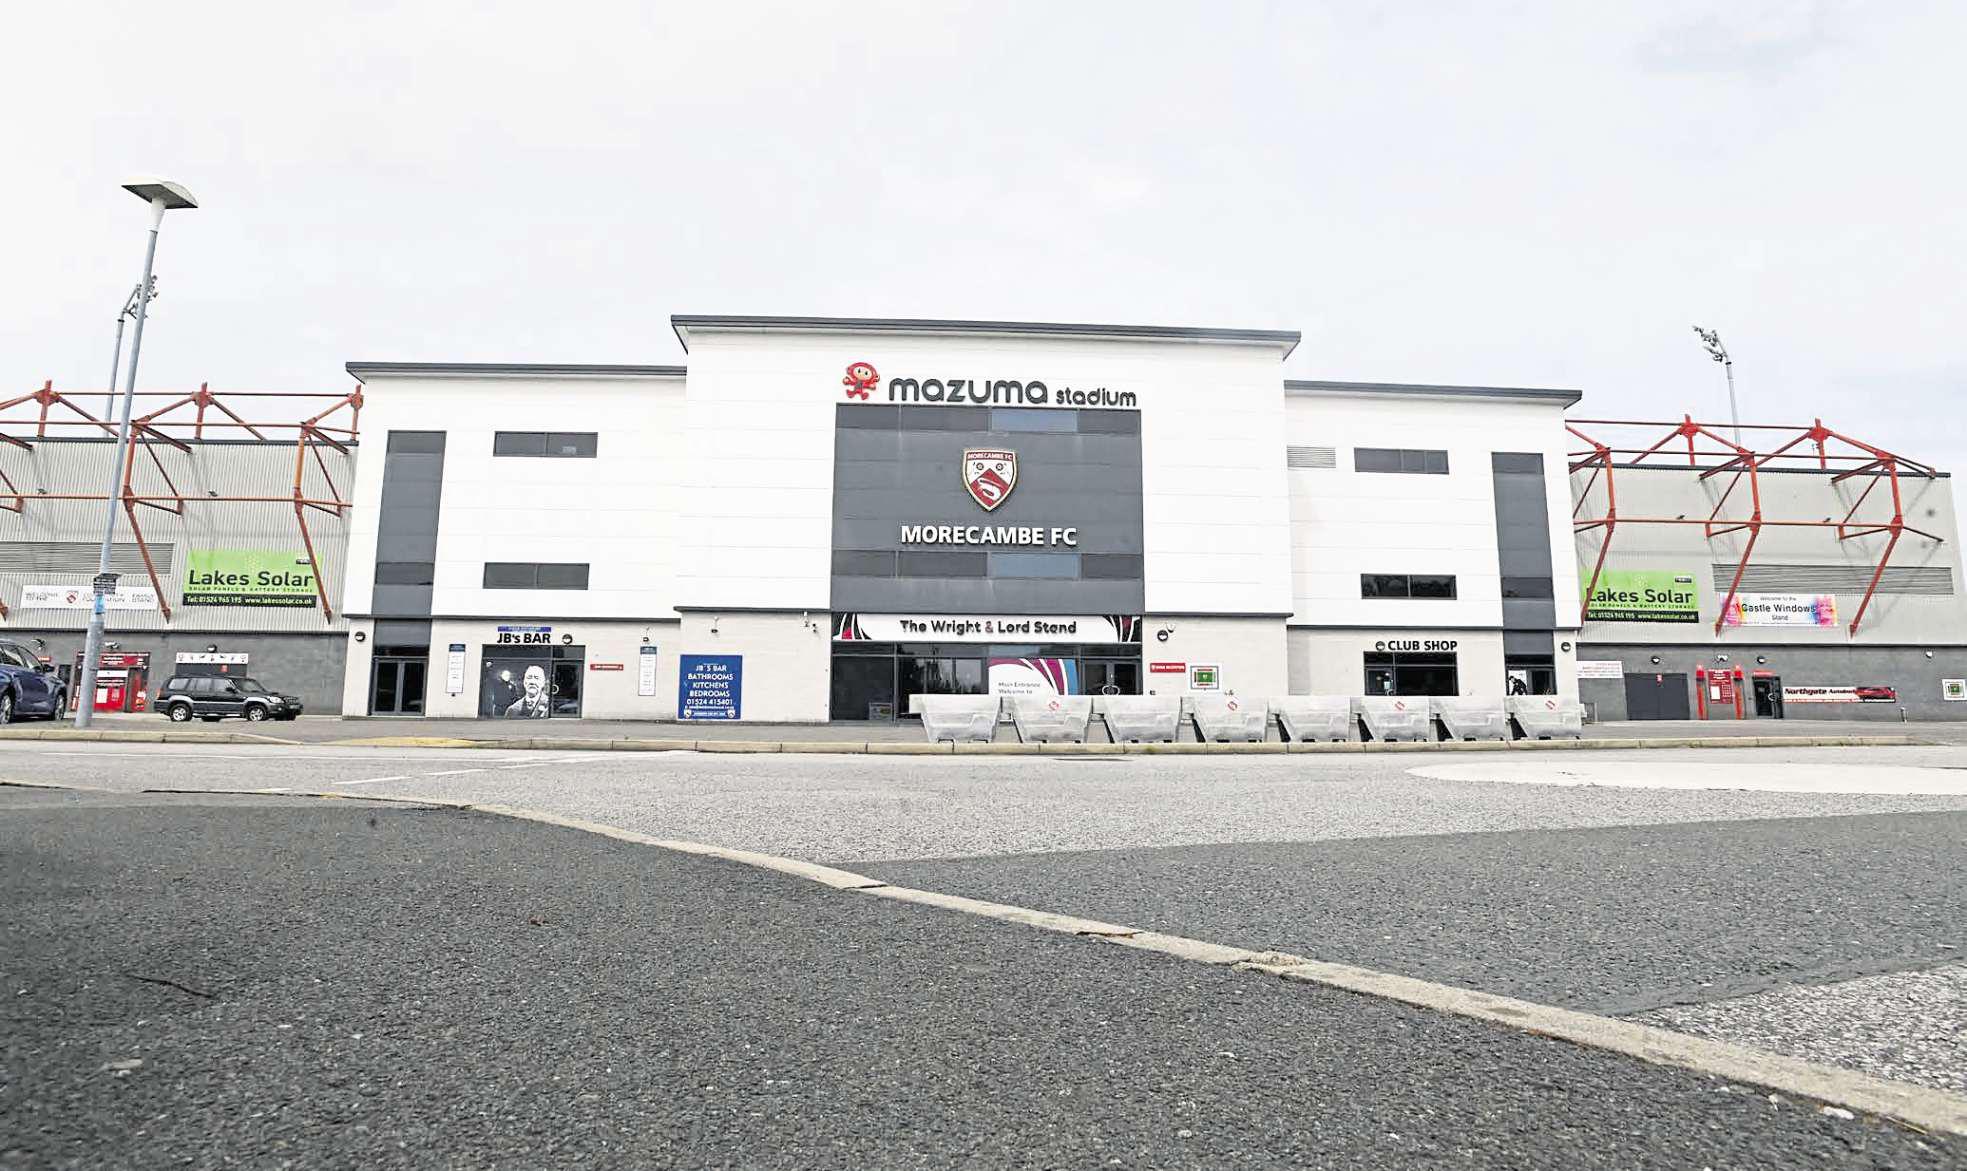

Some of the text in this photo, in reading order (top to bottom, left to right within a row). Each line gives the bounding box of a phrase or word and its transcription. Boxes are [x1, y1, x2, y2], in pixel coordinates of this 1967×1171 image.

[888, 377, 1138, 407] mazuma stadium
[901, 525, 1078, 547] MORECAMBE FC
[188, 569, 314, 587] Lakes Solar
[1644, 588, 1693, 604] Solar
[1741, 603, 1816, 613] Castle Windows
[899, 619, 1077, 636] The Wright & Lord Stand
[496, 633, 551, 644] JB's BAR
[1387, 640, 1457, 651] CLUB SHOP
[687, 672, 734, 680] BATHROOMS
[692, 681, 729, 689] KITCHENS
[1784, 688, 1827, 696] Northgate
